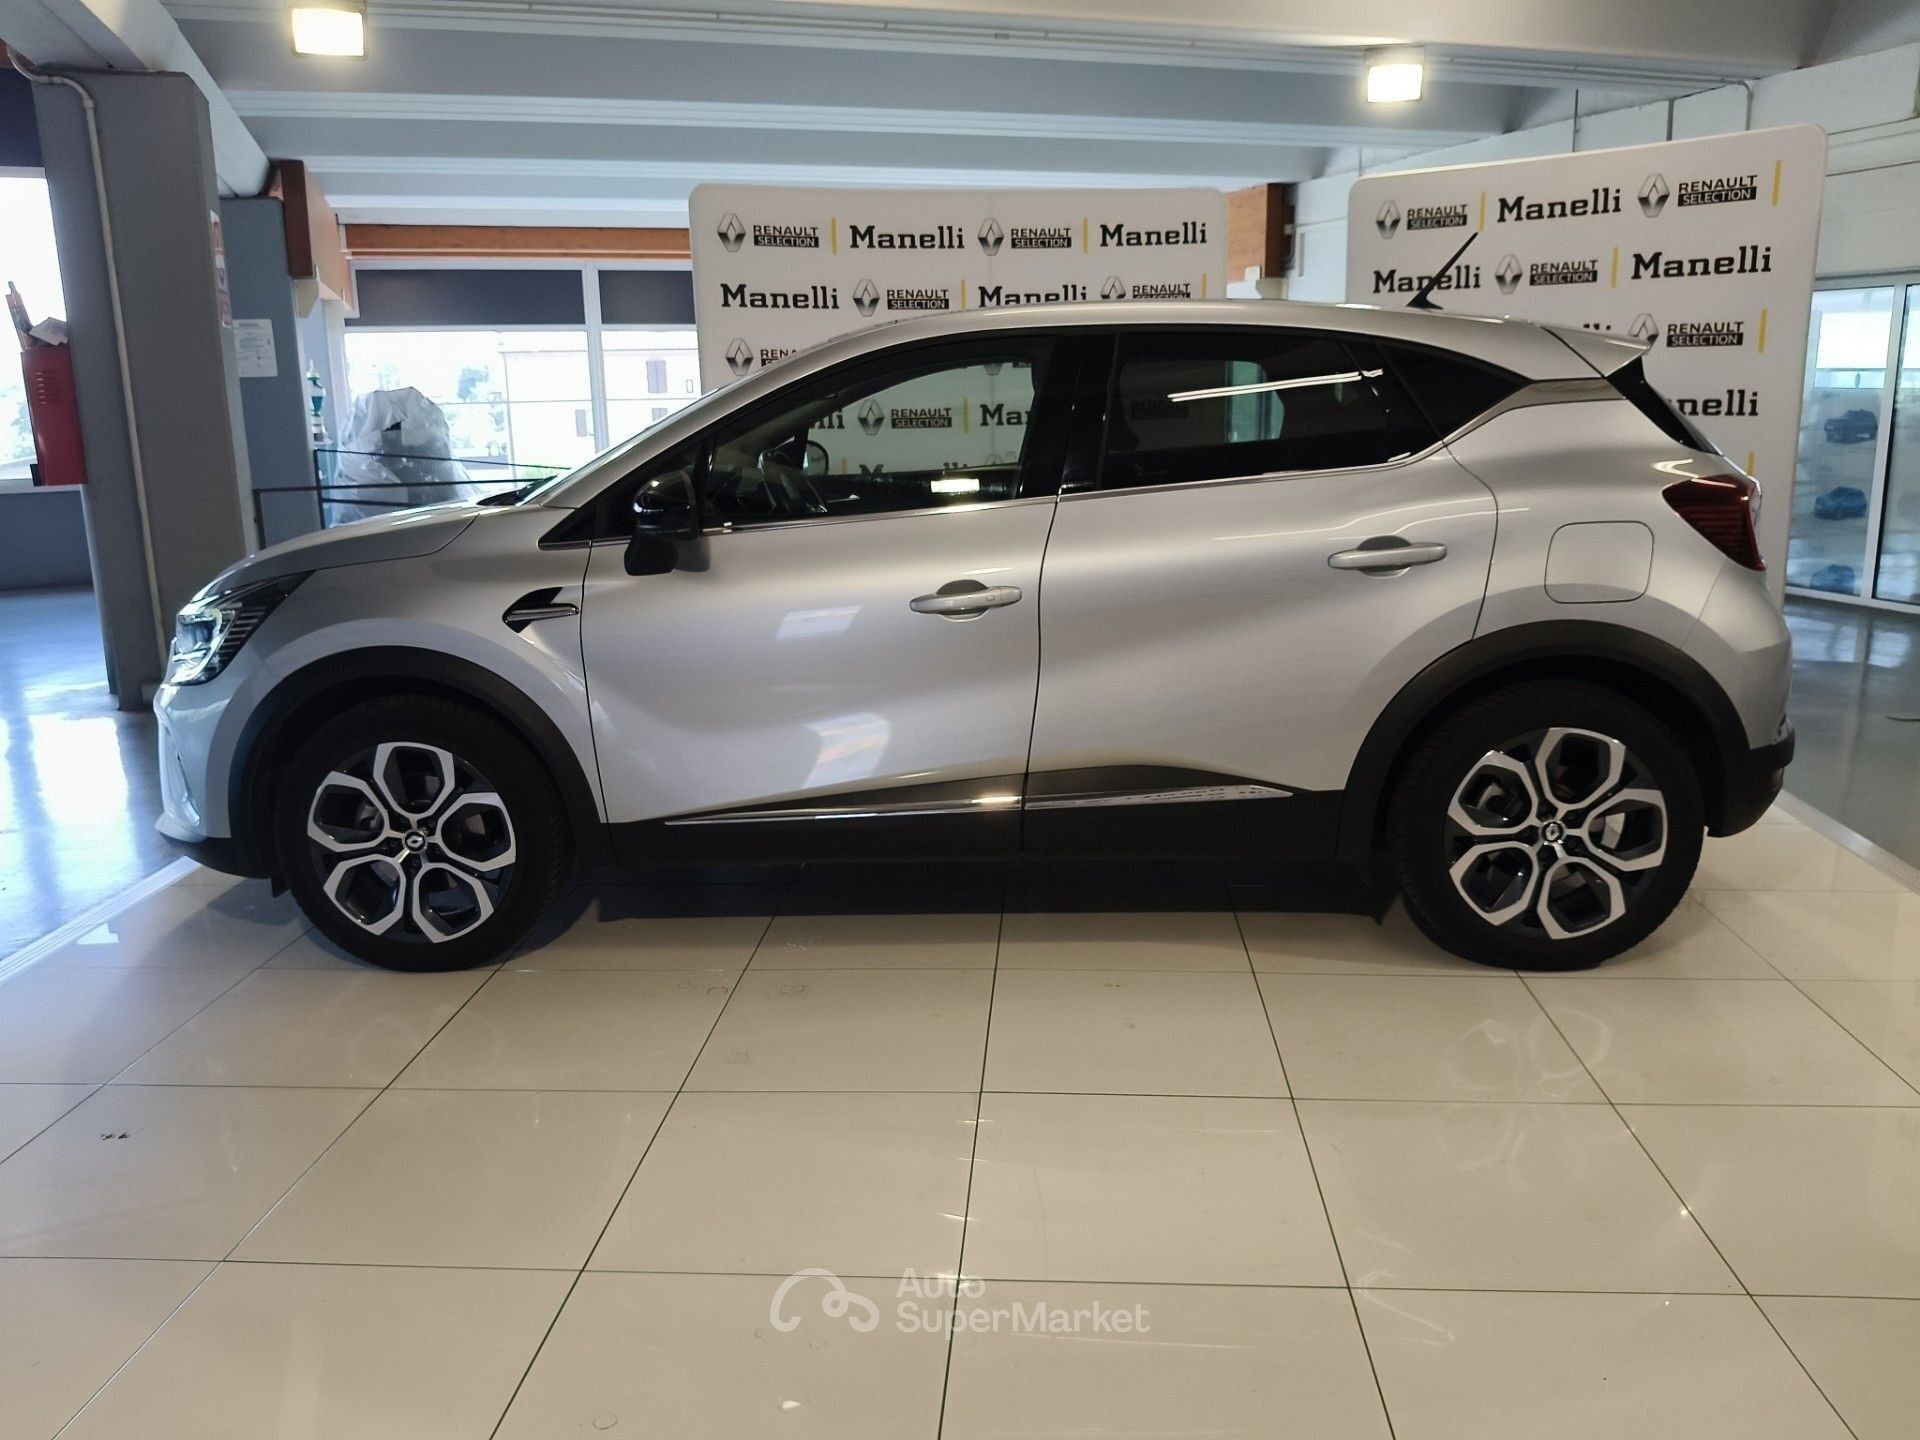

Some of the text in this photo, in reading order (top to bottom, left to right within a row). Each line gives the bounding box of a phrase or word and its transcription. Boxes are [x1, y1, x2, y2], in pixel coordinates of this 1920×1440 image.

[1678, 175, 1758, 193] RENAULT
[1682, 189, 1751, 206] SELECTION
[1407, 204, 1468, 220] RENAULT
[1497, 187, 1622, 223] Manelli
[1410, 216, 1464, 230] SELECTION
[753, 225, 818, 237] RENAULT
[849, 225, 965, 249] Manelli
[1010, 228, 1071, 238] RENAULT
[1100, 221, 1207, 246] Manelli
[757, 236, 815, 247] SELECTION
[1015, 237, 1068, 248] SELECTION
[1530, 259, 1598, 274] RENAULT
[1631, 245, 1772, 280] Manelli
[1533, 272, 1593, 286] SELECTION
[720, 283, 839, 309] Manelli
[886, 289, 949, 299] RENAULT
[1132, 283, 1191, 295] RENAULT
[891, 299, 946, 309] SELECTION
[1667, 321, 1744, 335] RENAULT
[1671, 333, 1738, 347] SELECTION
[1670, 389, 1758, 417] nelli
[891, 407, 952, 418] RENAULT
[894, 418, 948, 428] SELECTION
